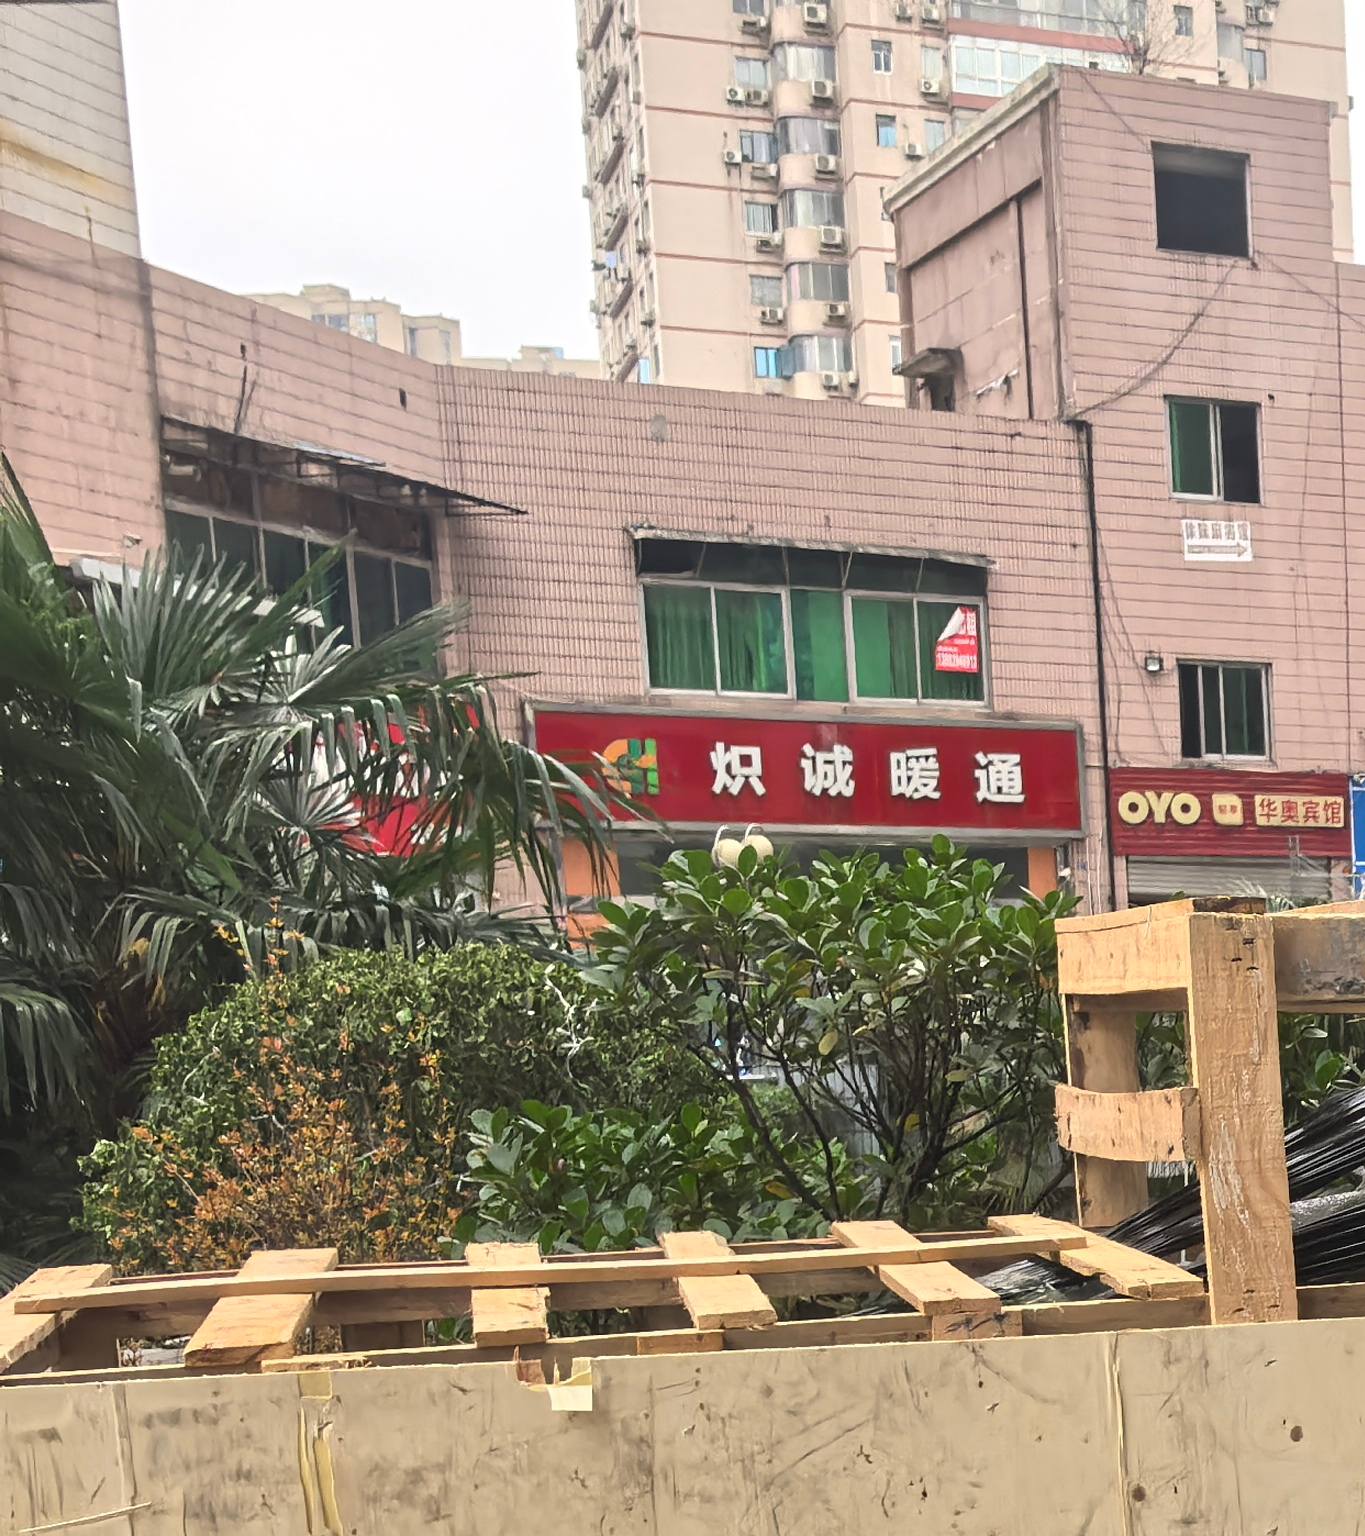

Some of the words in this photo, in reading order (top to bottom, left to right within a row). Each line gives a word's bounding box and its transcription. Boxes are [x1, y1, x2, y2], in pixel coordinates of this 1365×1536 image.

[710, 741, 1025, 803] 炽诚暖通
[1118, 791, 1201, 825] OYO
[1258, 798, 1342, 825] 华奥宾馆
